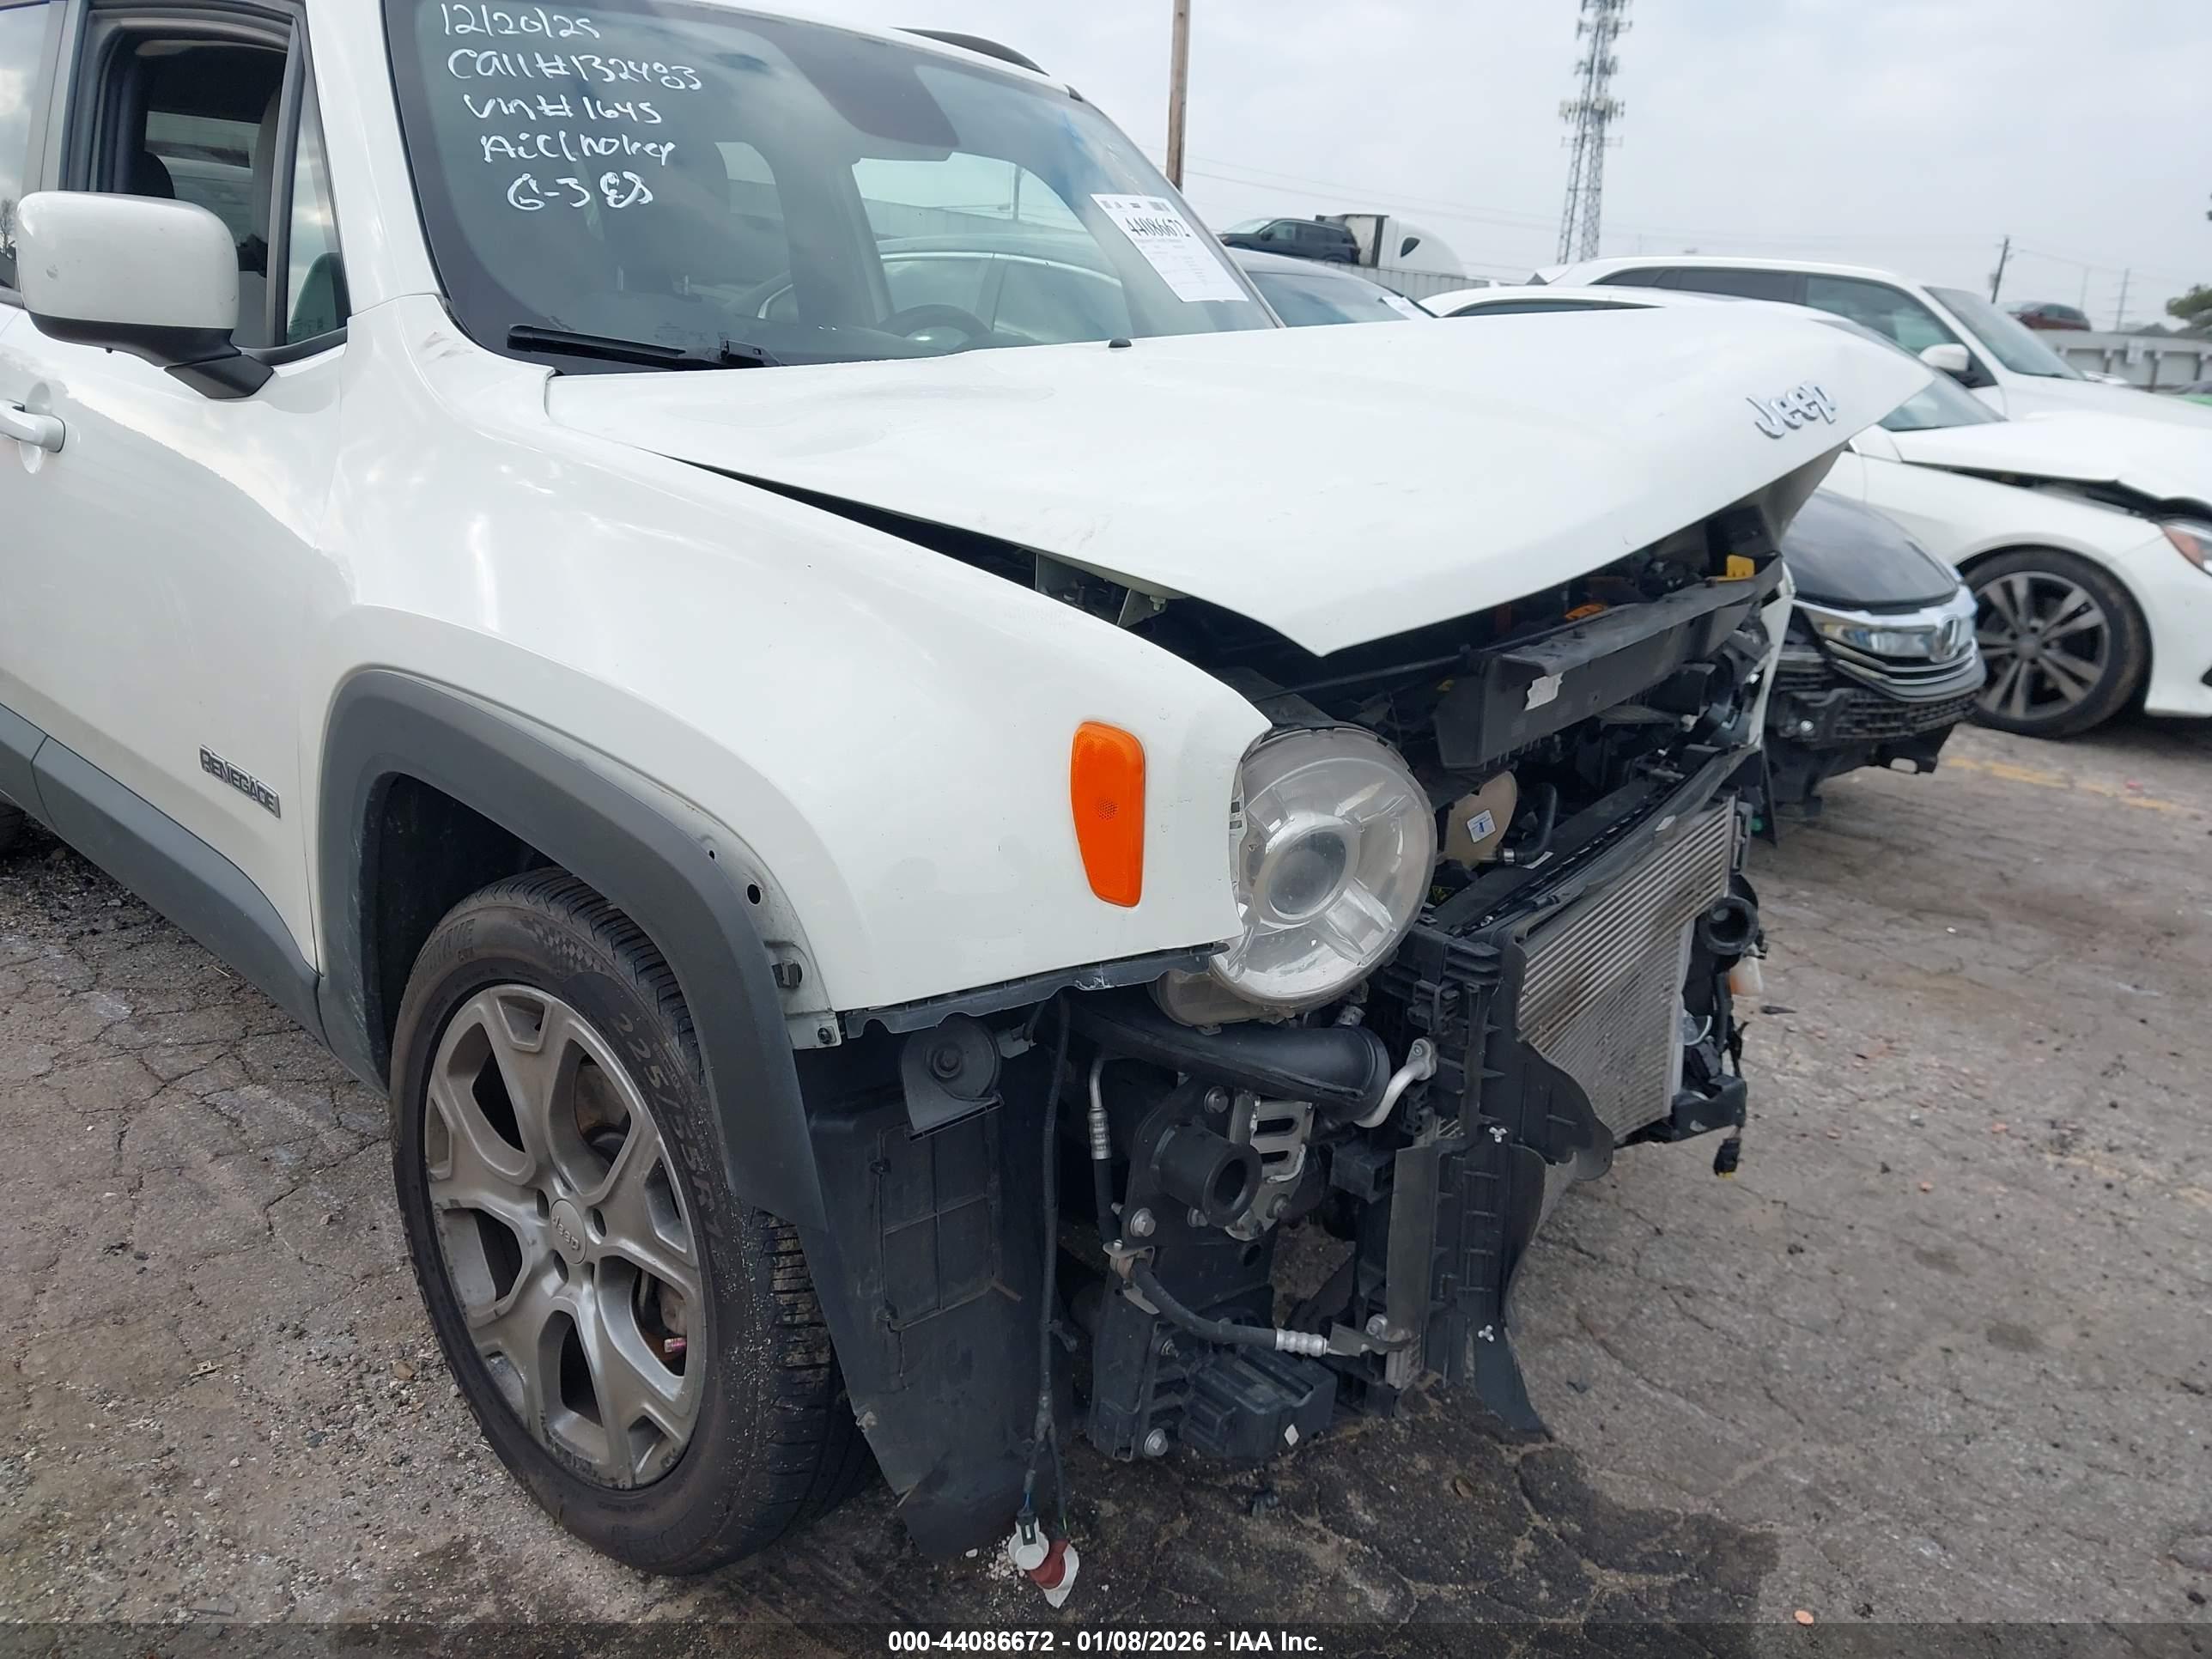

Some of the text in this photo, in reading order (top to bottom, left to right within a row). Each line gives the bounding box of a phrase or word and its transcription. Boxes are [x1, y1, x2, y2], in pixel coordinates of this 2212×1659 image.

[1745, 383, 1836, 440] Jeep
[198, 745, 279, 817] RENEGADE
[551, 1215, 580, 1251] Jeep
